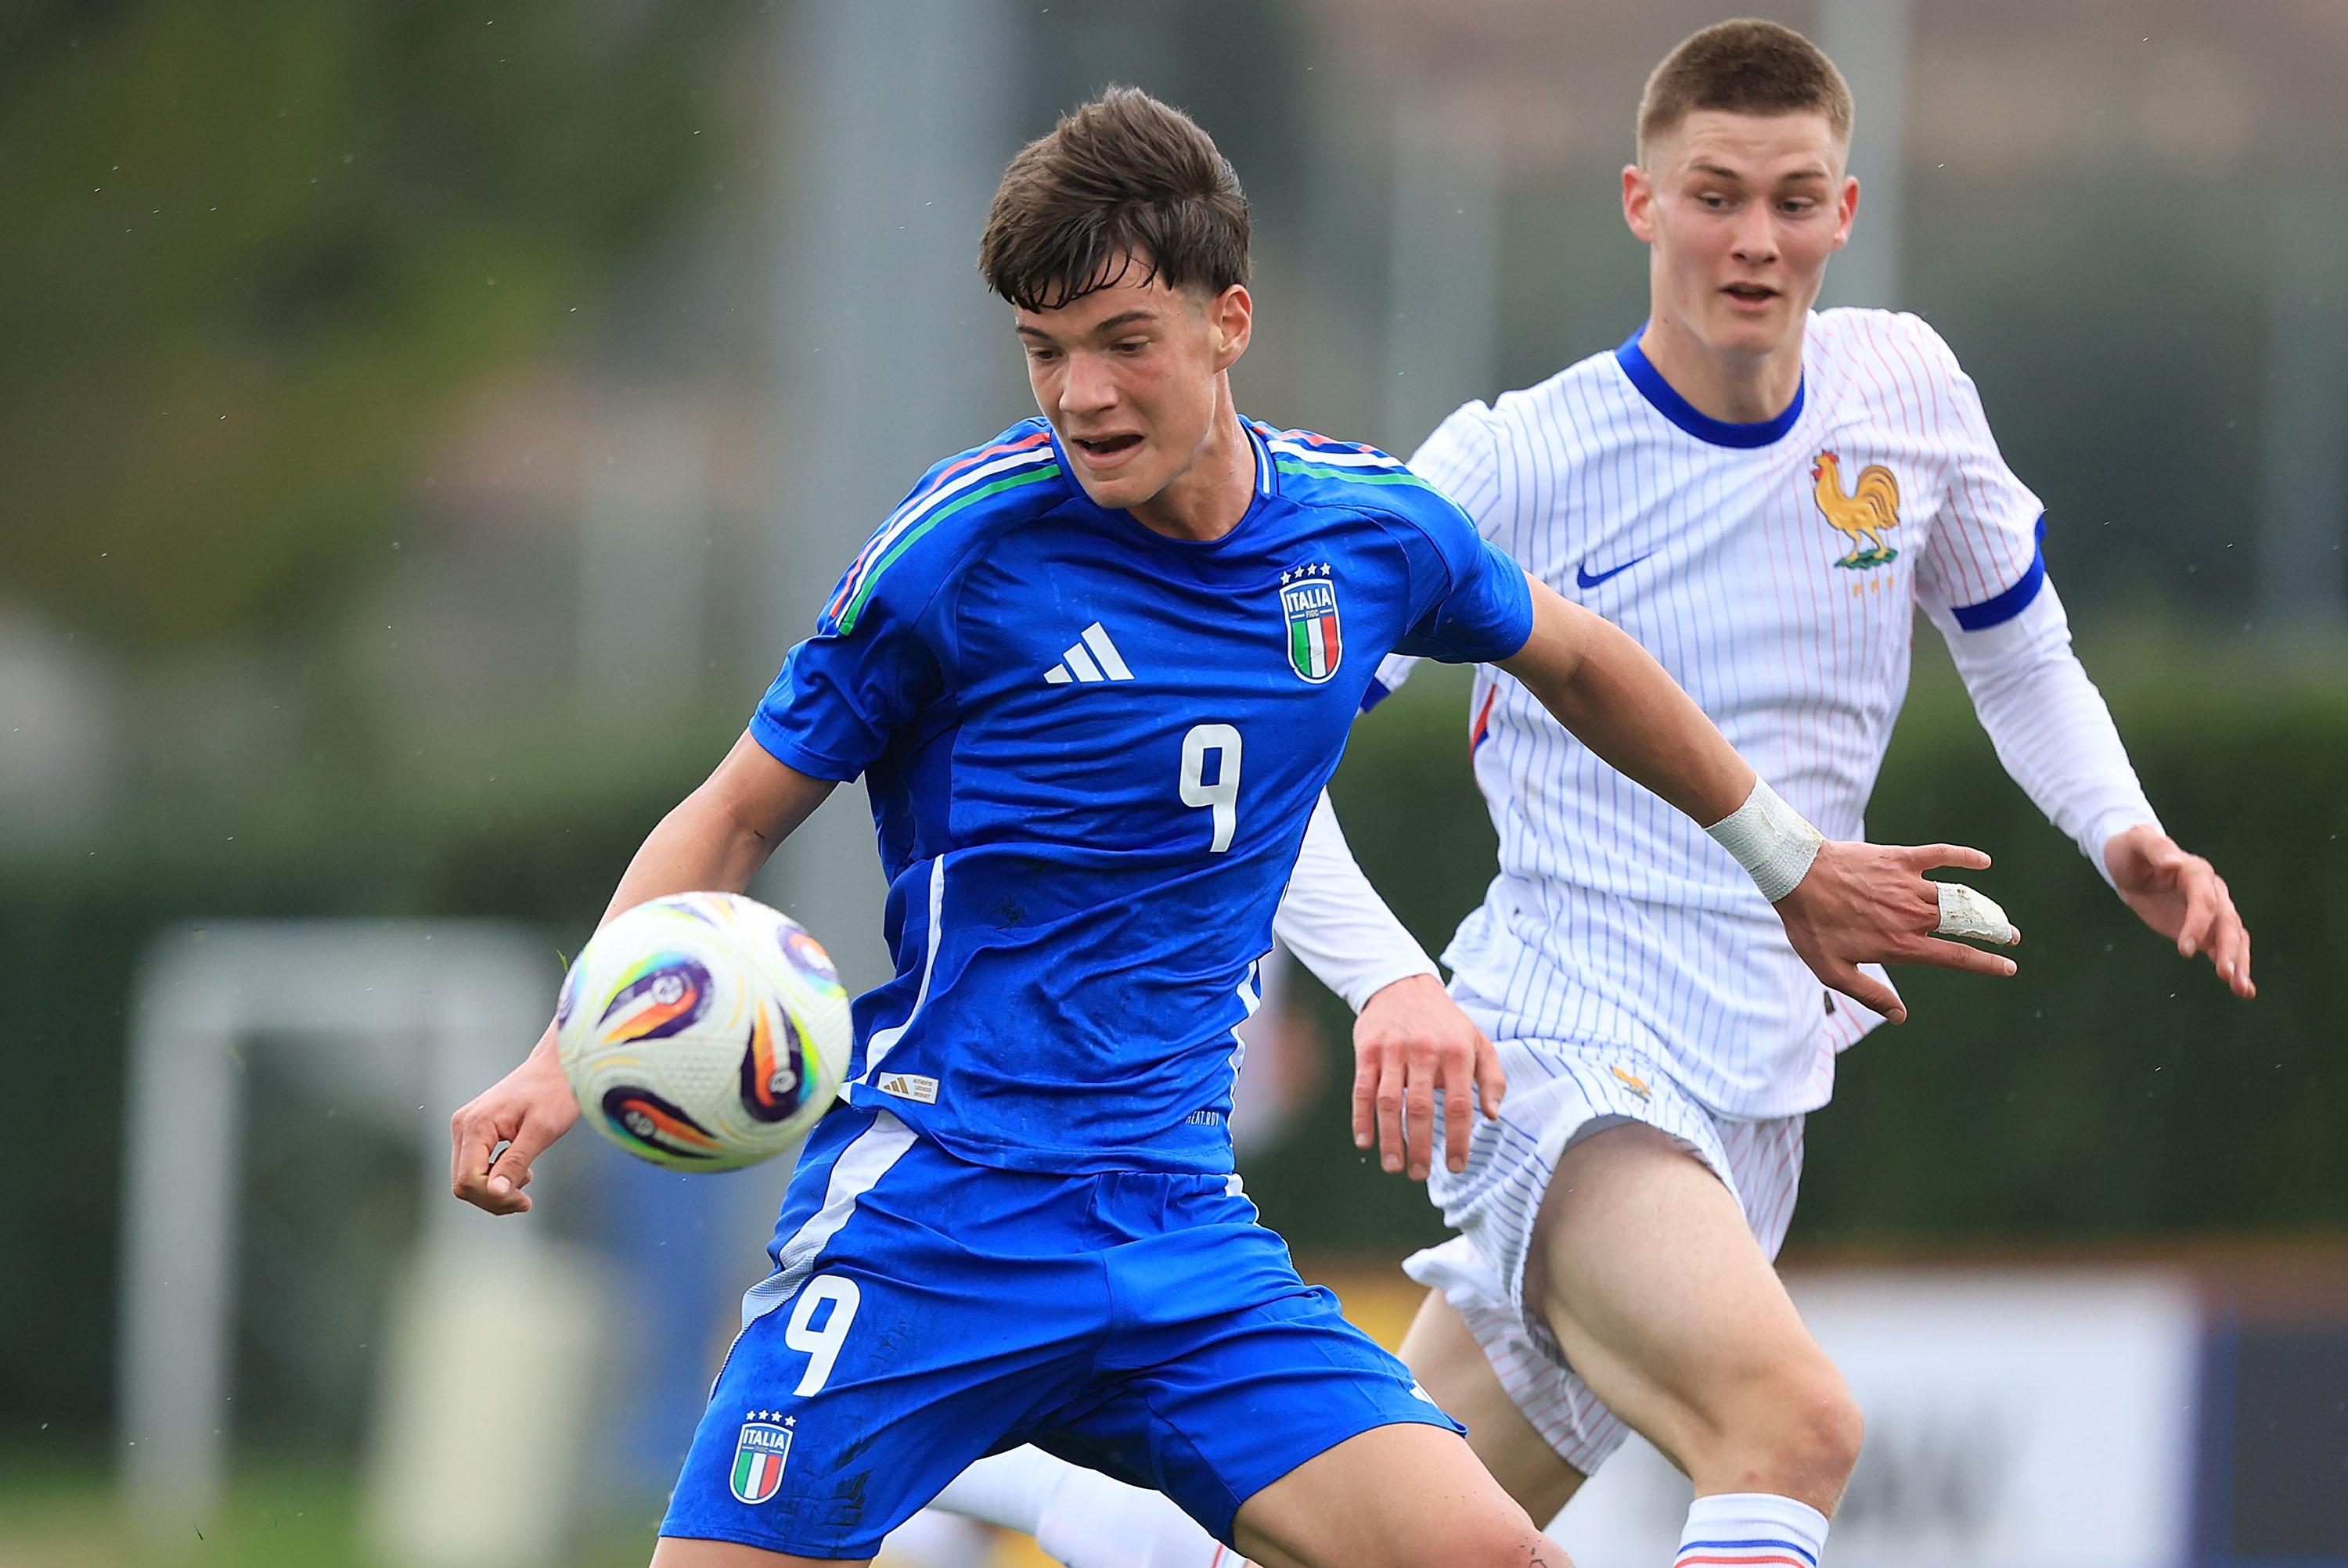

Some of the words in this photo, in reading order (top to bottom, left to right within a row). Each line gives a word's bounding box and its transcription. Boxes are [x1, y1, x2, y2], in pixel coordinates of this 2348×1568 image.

[1285, 587, 1332, 613] ITALIA
[1179, 724, 1242, 853] 9
[785, 1275, 861, 1397] 9
[743, 1429, 784, 1450] ITALIA
